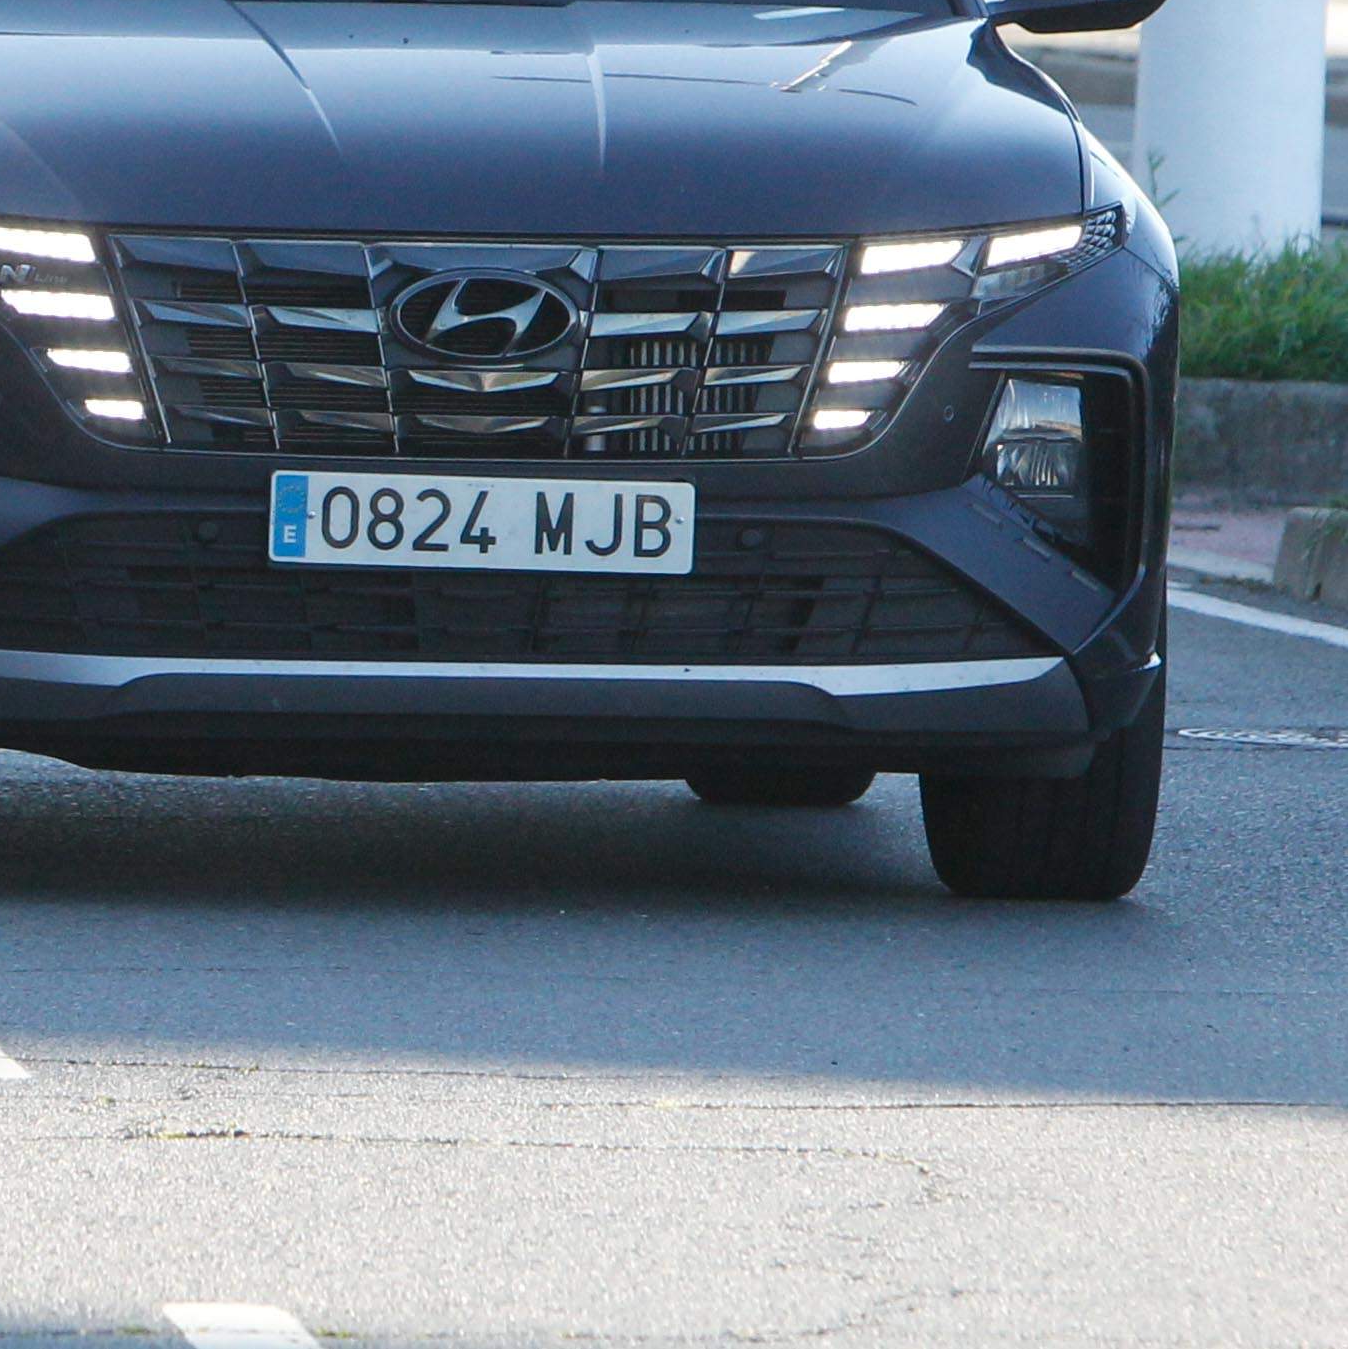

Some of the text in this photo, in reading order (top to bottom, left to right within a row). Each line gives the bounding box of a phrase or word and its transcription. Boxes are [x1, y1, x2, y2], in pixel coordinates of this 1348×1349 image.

[282, 485, 673, 559] E 0824 MJB
